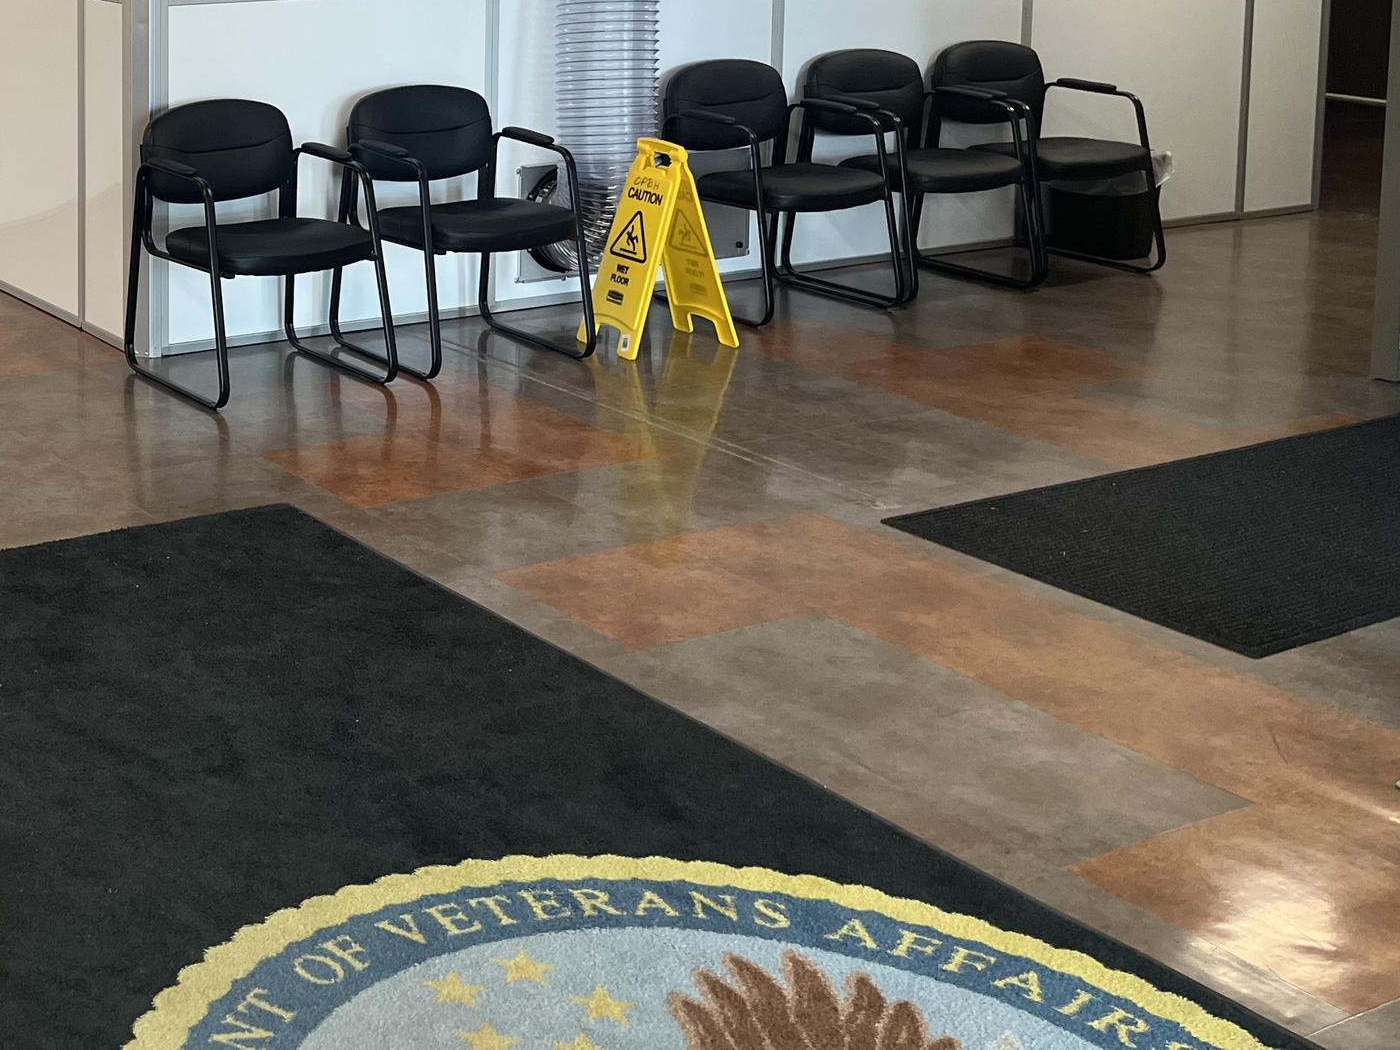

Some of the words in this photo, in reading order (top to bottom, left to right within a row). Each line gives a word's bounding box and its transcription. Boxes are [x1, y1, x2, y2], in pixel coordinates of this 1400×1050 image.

[627, 186, 663, 206] CAUTION
[616, 263, 630, 275] WET
[610, 273, 630, 286] FLOOR
[292, 935, 370, 985] OF
[376, 887, 790, 943] VETERANS
[822, 916, 1200, 1050] AFFAIR
